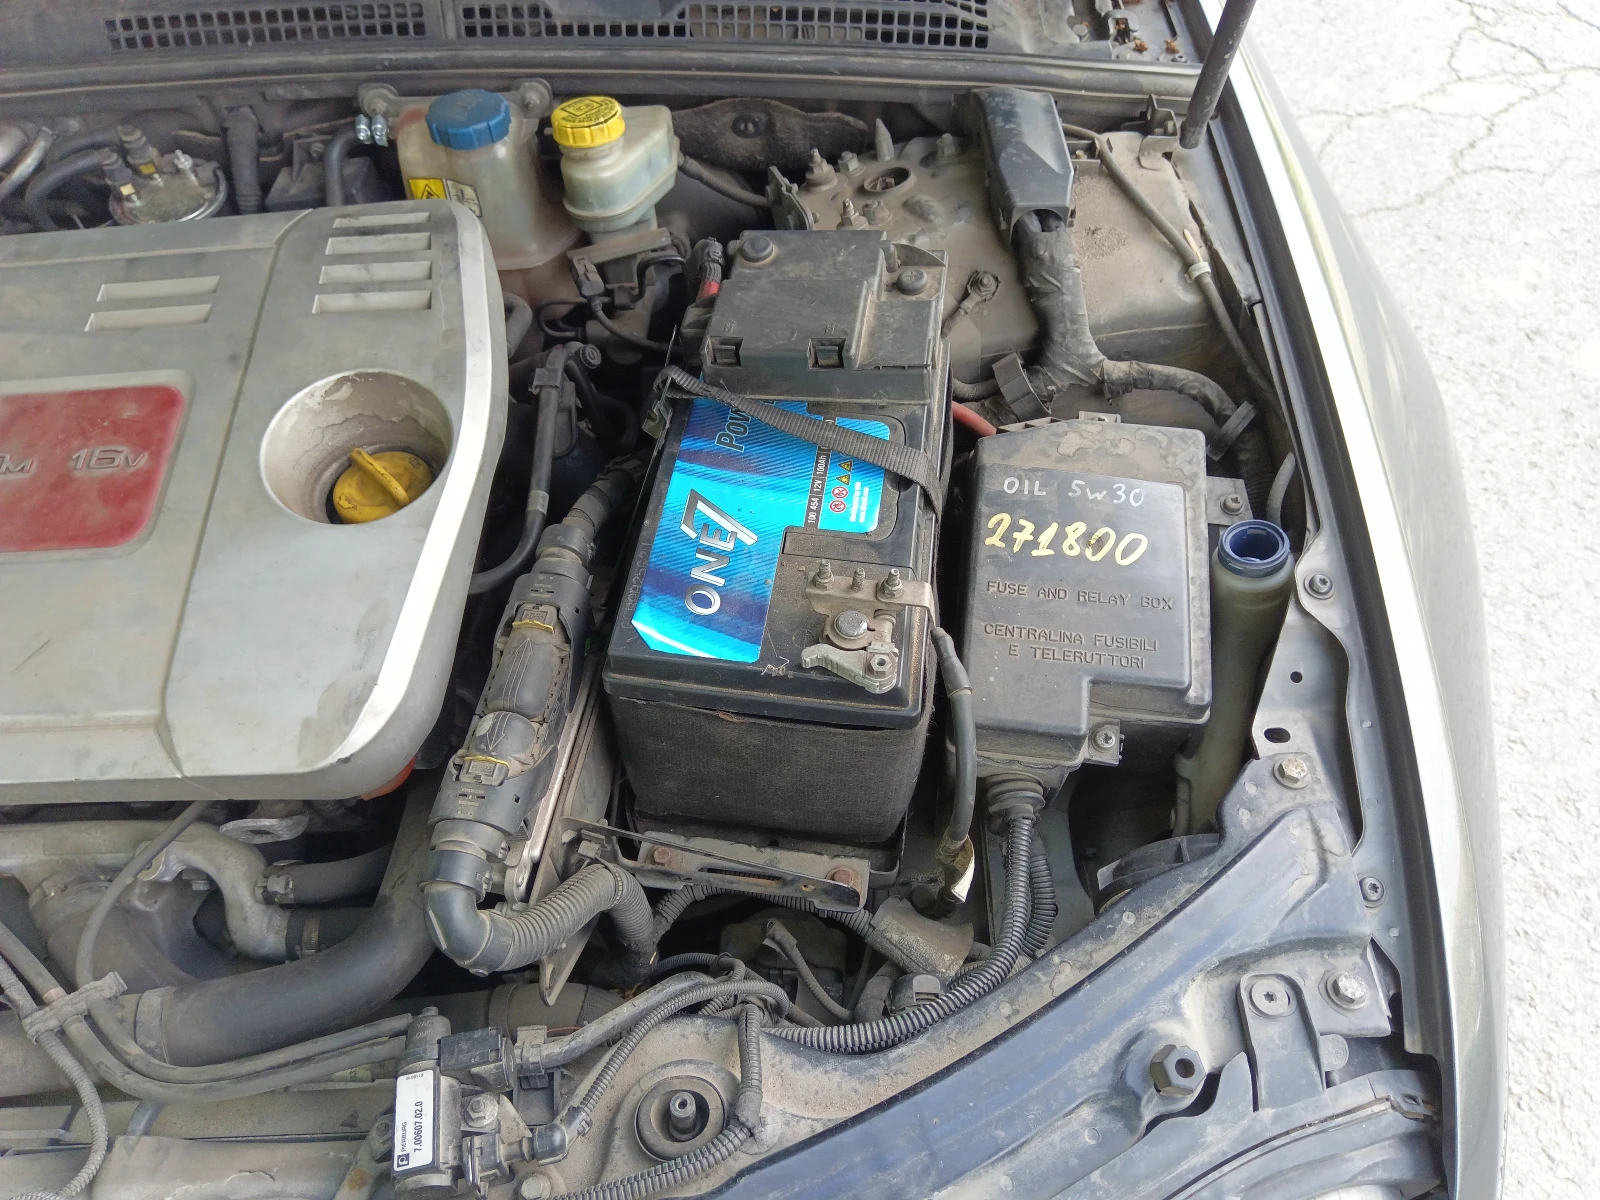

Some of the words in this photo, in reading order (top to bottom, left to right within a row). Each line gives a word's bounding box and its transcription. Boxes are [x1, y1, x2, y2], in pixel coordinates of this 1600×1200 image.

[816, 455, 827, 475] 100Ah
[813, 479, 823, 492] 12V
[1003, 477, 1047, 496] OIL
[809, 497, 820, 511] 454
[807, 511, 817, 523] 100
[984, 512, 1148, 566] 271800
[987, 580, 1028, 596] FUSE
[1037, 587, 1067, 601] AND
[1077, 591, 1130, 607] RELAY
[1140, 596, 1173, 611] BOX
[984, 623, 1083, 645] CENTRALINA
[1093, 634, 1158, 652] FUSIBILI
[1008, 644, 1019, 657] E
[1030, 645, 1144, 669] TELERUTTORI
[413, 1101, 424, 1153] 7.00607.02.0
